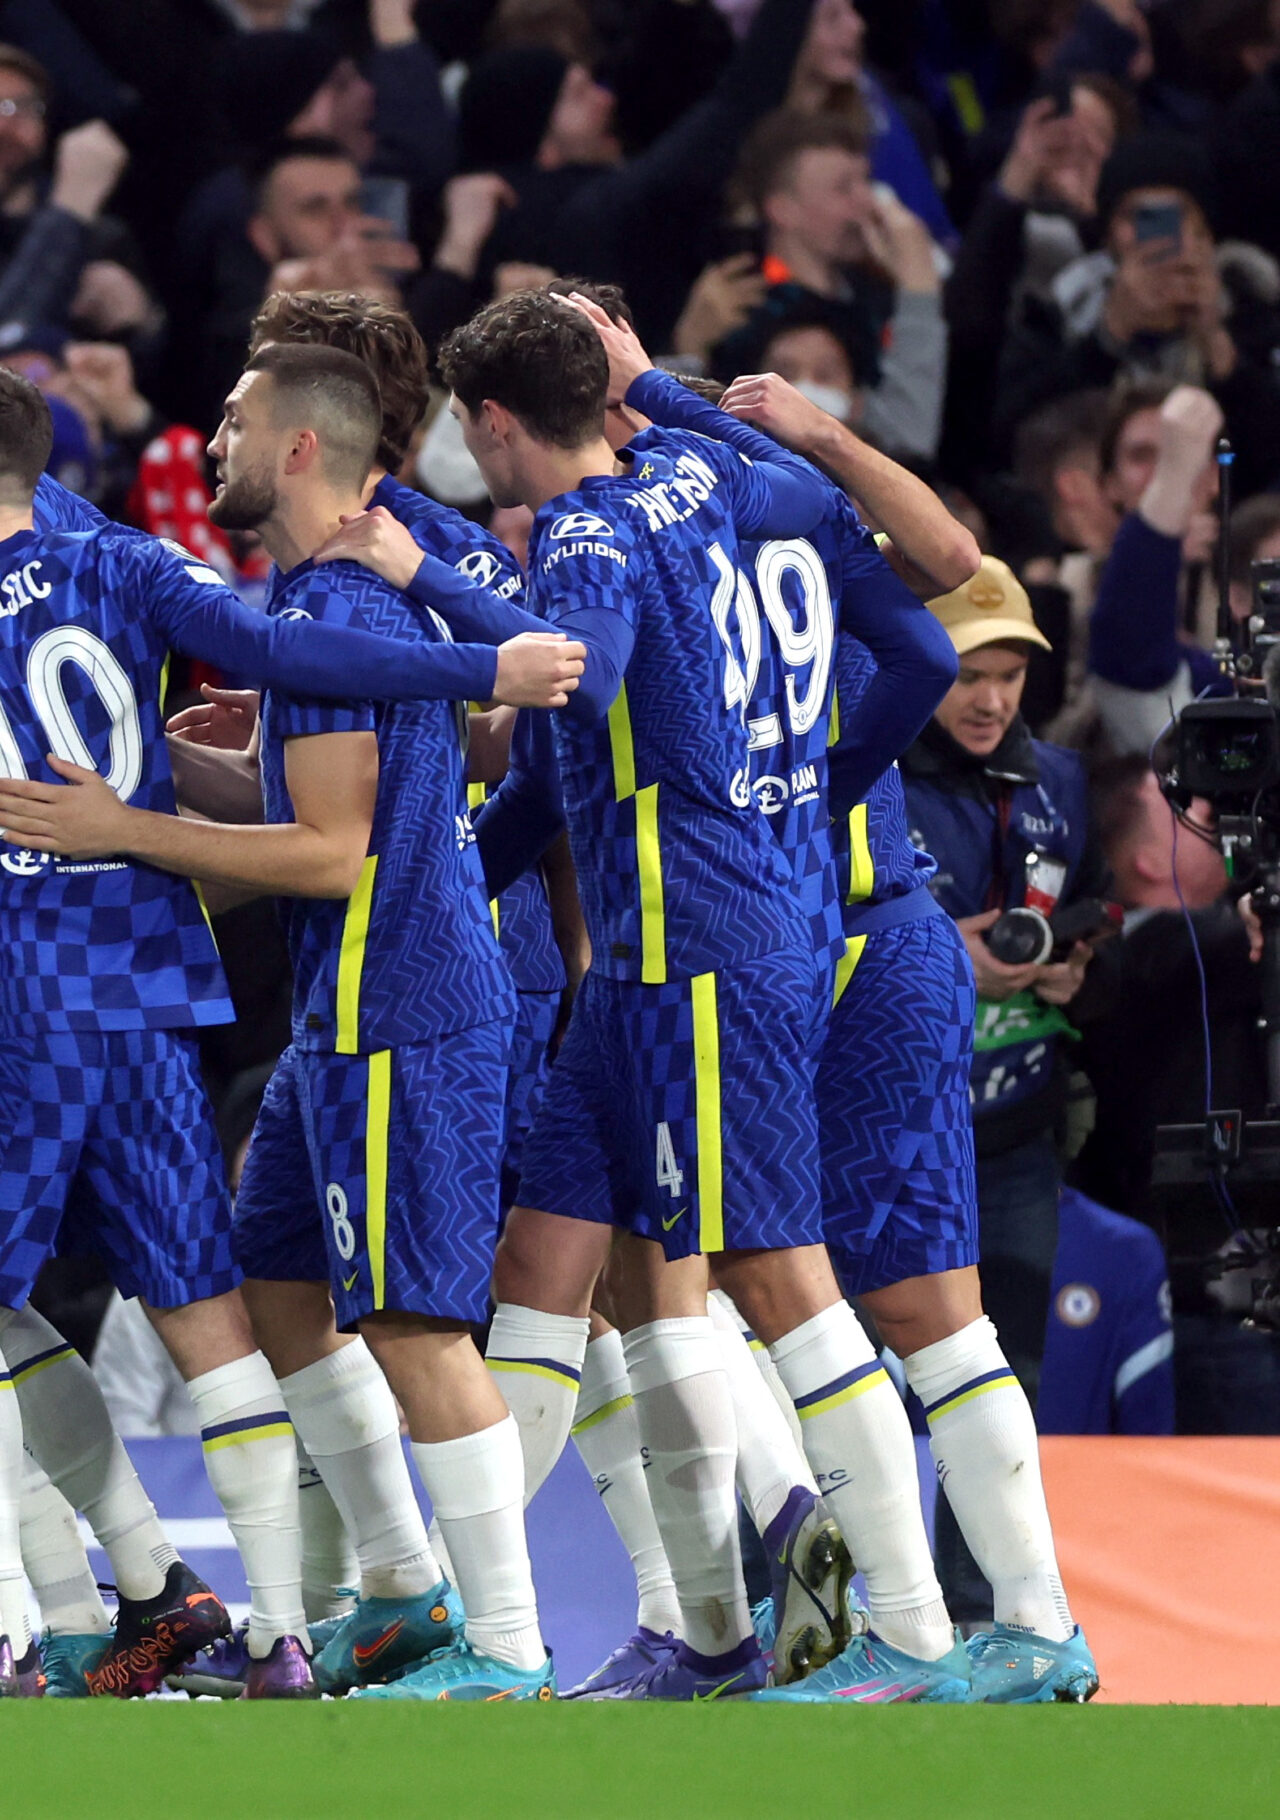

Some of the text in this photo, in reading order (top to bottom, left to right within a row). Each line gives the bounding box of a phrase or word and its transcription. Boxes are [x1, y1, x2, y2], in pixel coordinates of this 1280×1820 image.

[543, 541, 628, 575] HYUNDAI
[55, 862, 128, 873] INTERNATIONAL
[656, 1121, 684, 1197] 4
[326, 1182, 356, 1261] 8
[814, 1469, 848, 1484] FC
